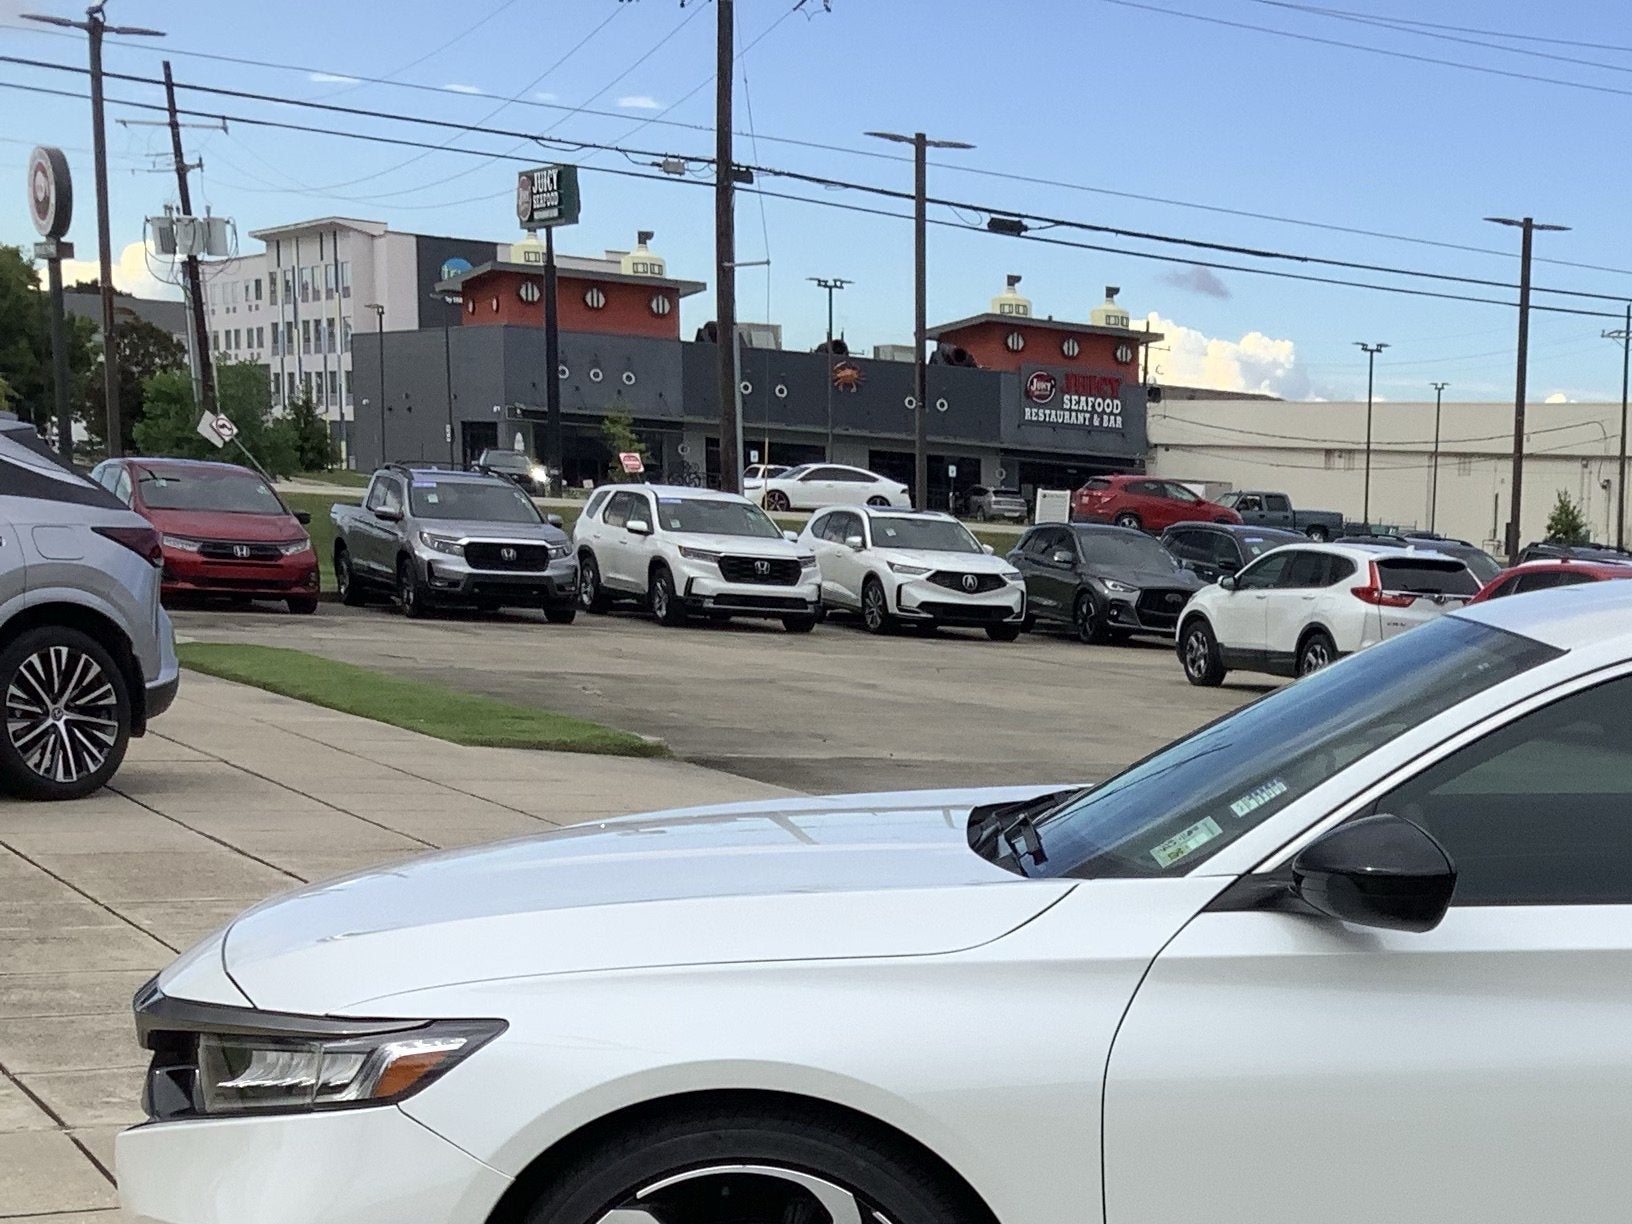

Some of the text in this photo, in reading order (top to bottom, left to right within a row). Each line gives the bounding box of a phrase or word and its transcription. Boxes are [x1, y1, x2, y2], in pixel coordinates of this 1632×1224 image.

[532, 169, 559, 193] JUICY
[1063, 394, 1121, 413] SEAFOOD
[1025, 407, 1123, 428] RESTAURANT & BAR
